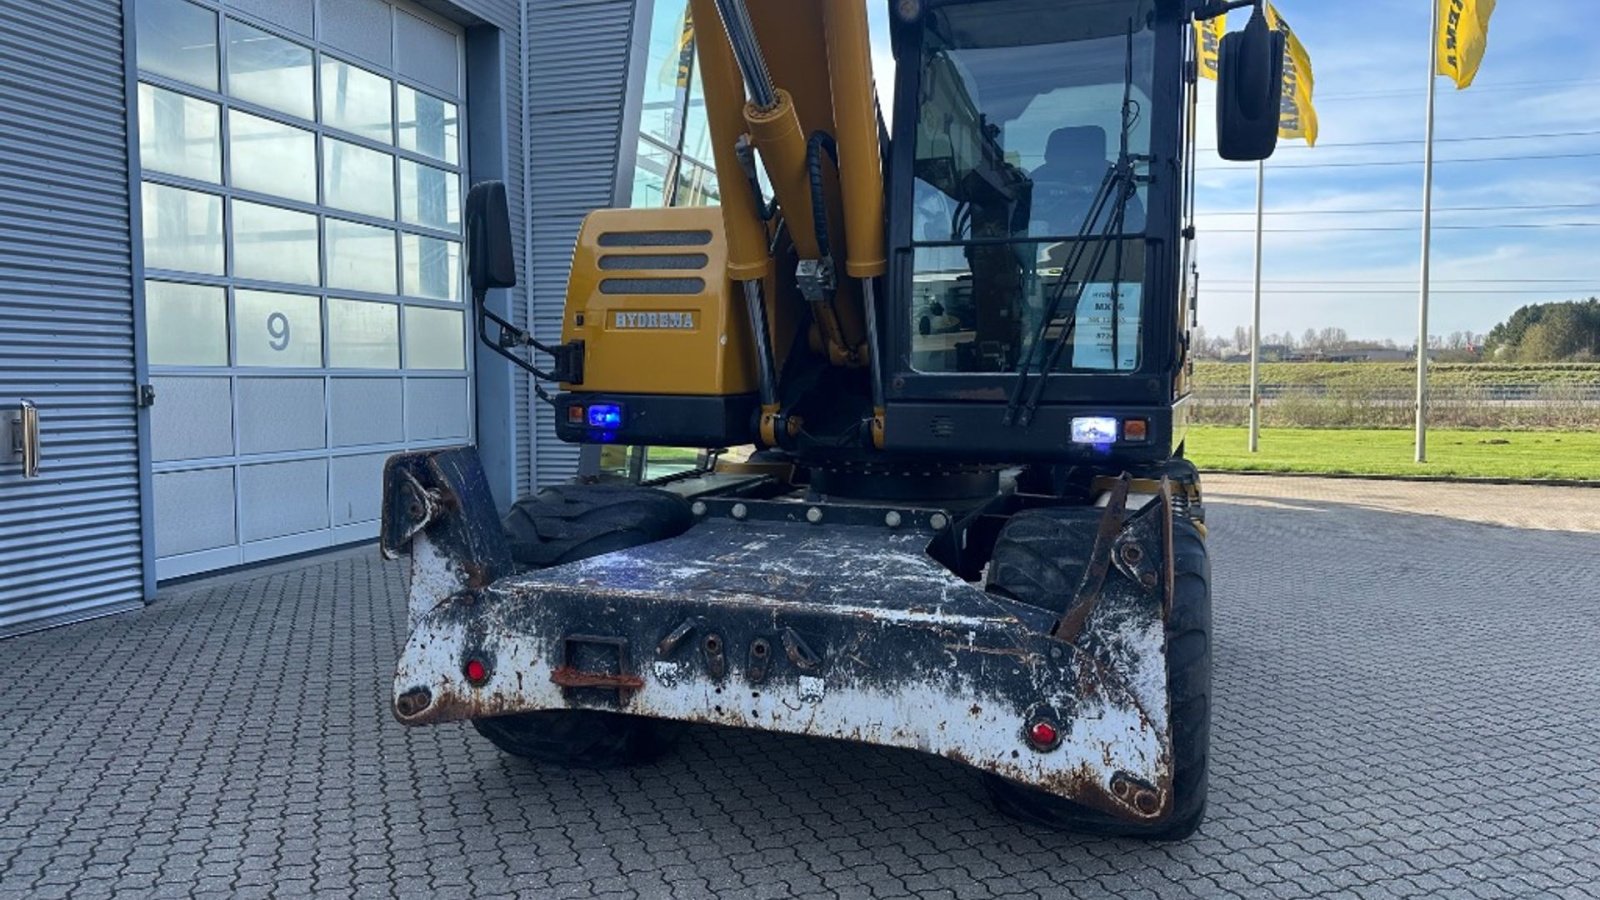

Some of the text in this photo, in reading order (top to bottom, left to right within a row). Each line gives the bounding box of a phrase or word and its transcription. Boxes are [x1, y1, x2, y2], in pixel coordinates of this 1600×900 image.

[1095, 302, 1125, 311] MX6
[615, 311, 694, 329] HYDREMA
[267, 312, 290, 351] 9
